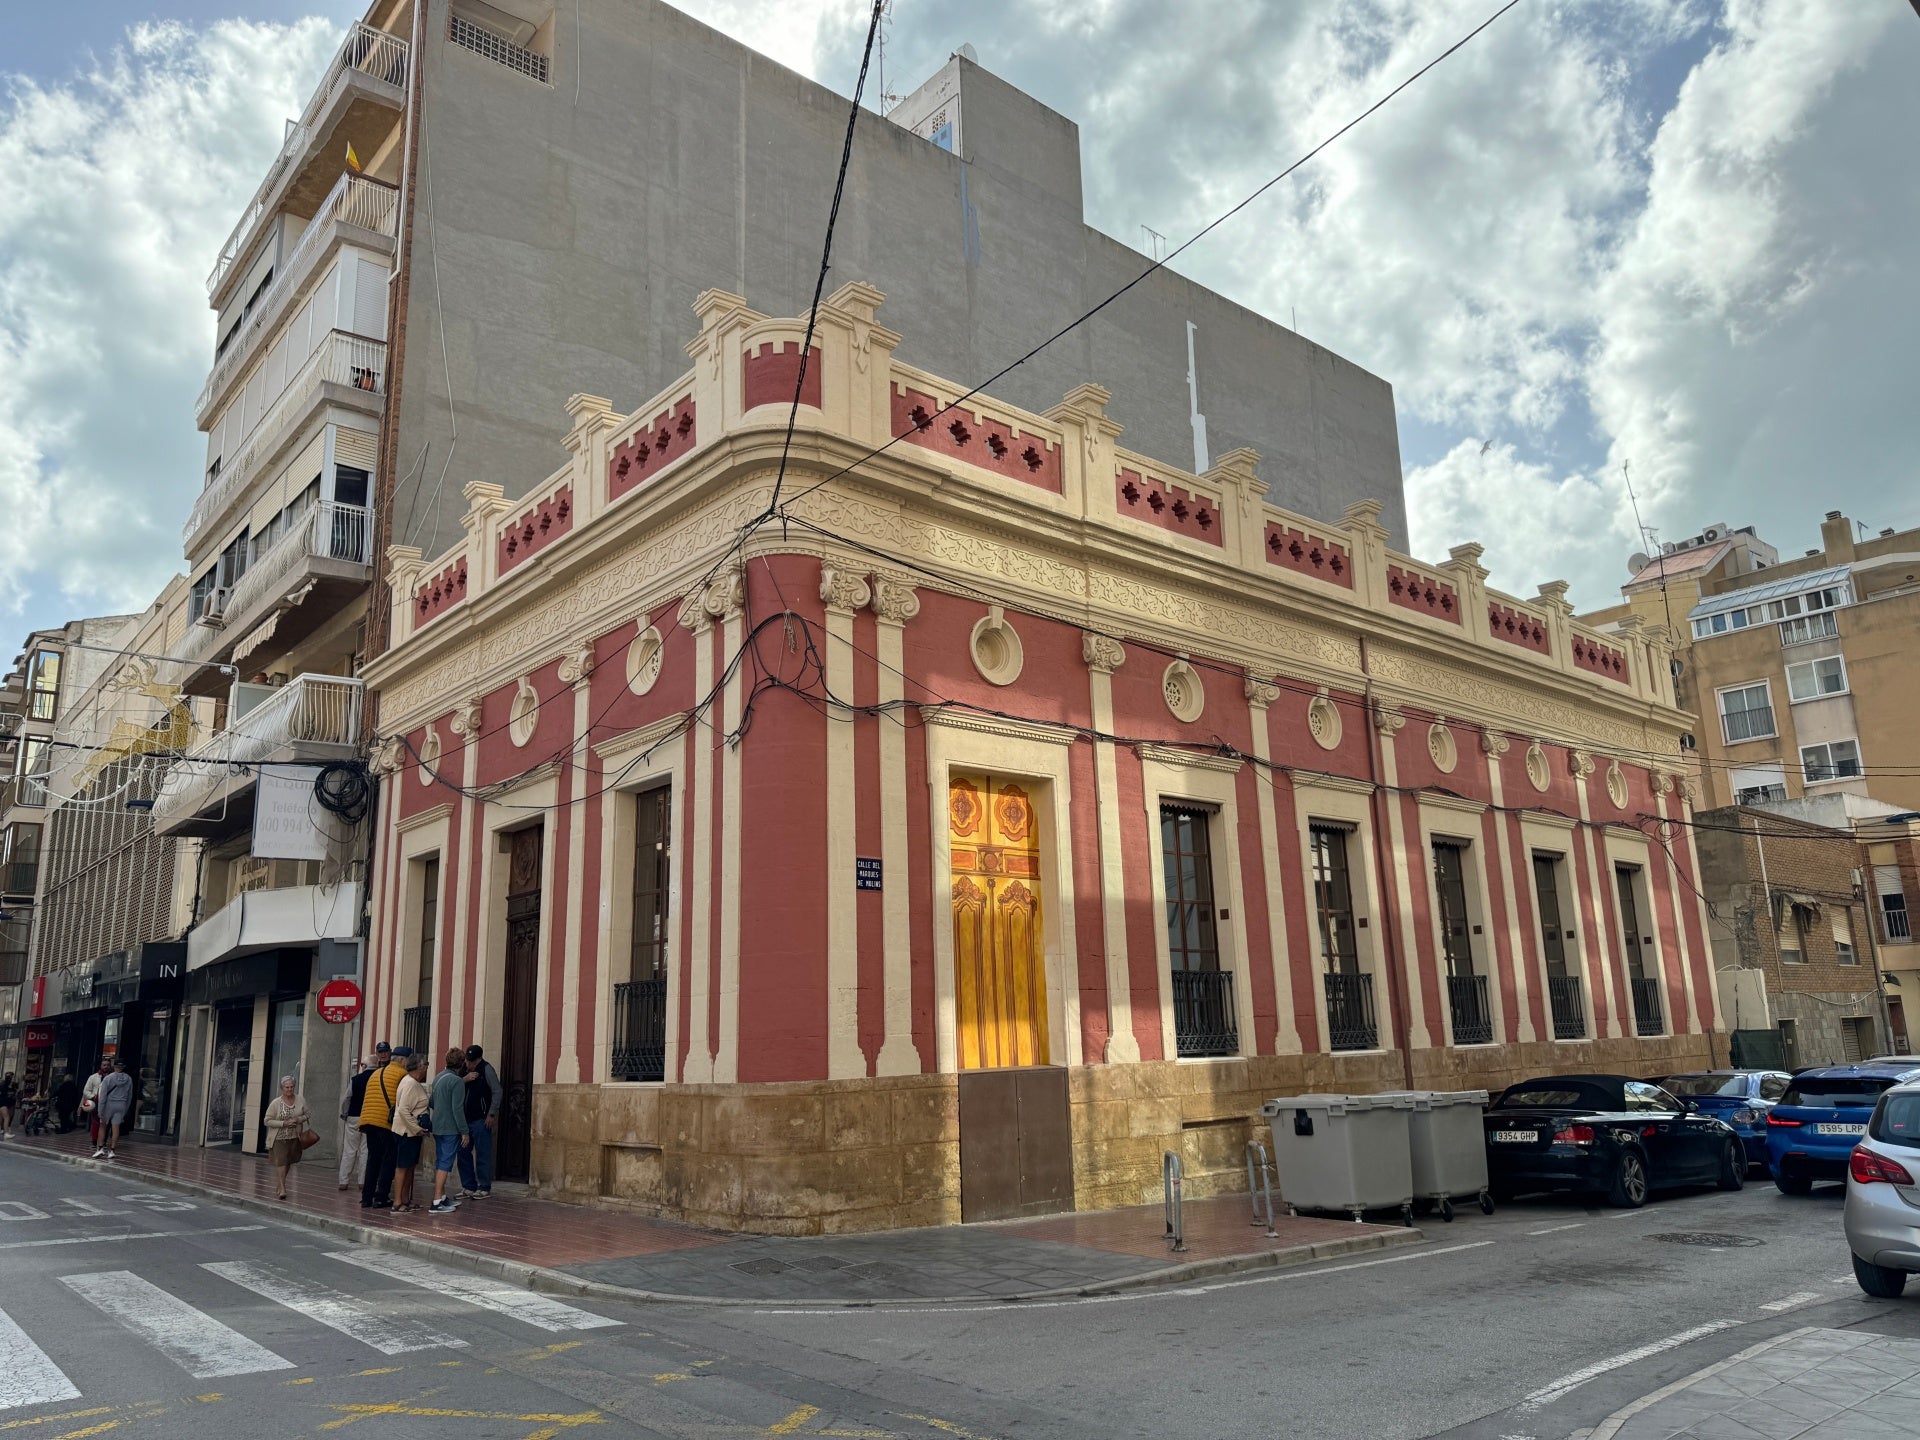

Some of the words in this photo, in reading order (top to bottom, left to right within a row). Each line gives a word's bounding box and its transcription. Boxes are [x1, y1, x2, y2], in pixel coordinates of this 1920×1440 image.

[265, 780, 314, 791] ALQUI
[857, 861, 871, 869] CALLE
[872, 861, 880, 869] DEL
[857, 879, 864, 887] DE
[865, 880, 881, 888] MOLINS
[159, 964, 177, 978] IN
[1820, 1124, 1843, 1133] 3595
[1845, 1124, 1863, 1133] LRP
[1497, 1132, 1518, 1141] 9354
[1520, 1132, 1536, 1141] GHP
[0, 1194, 200, 1221] STO
